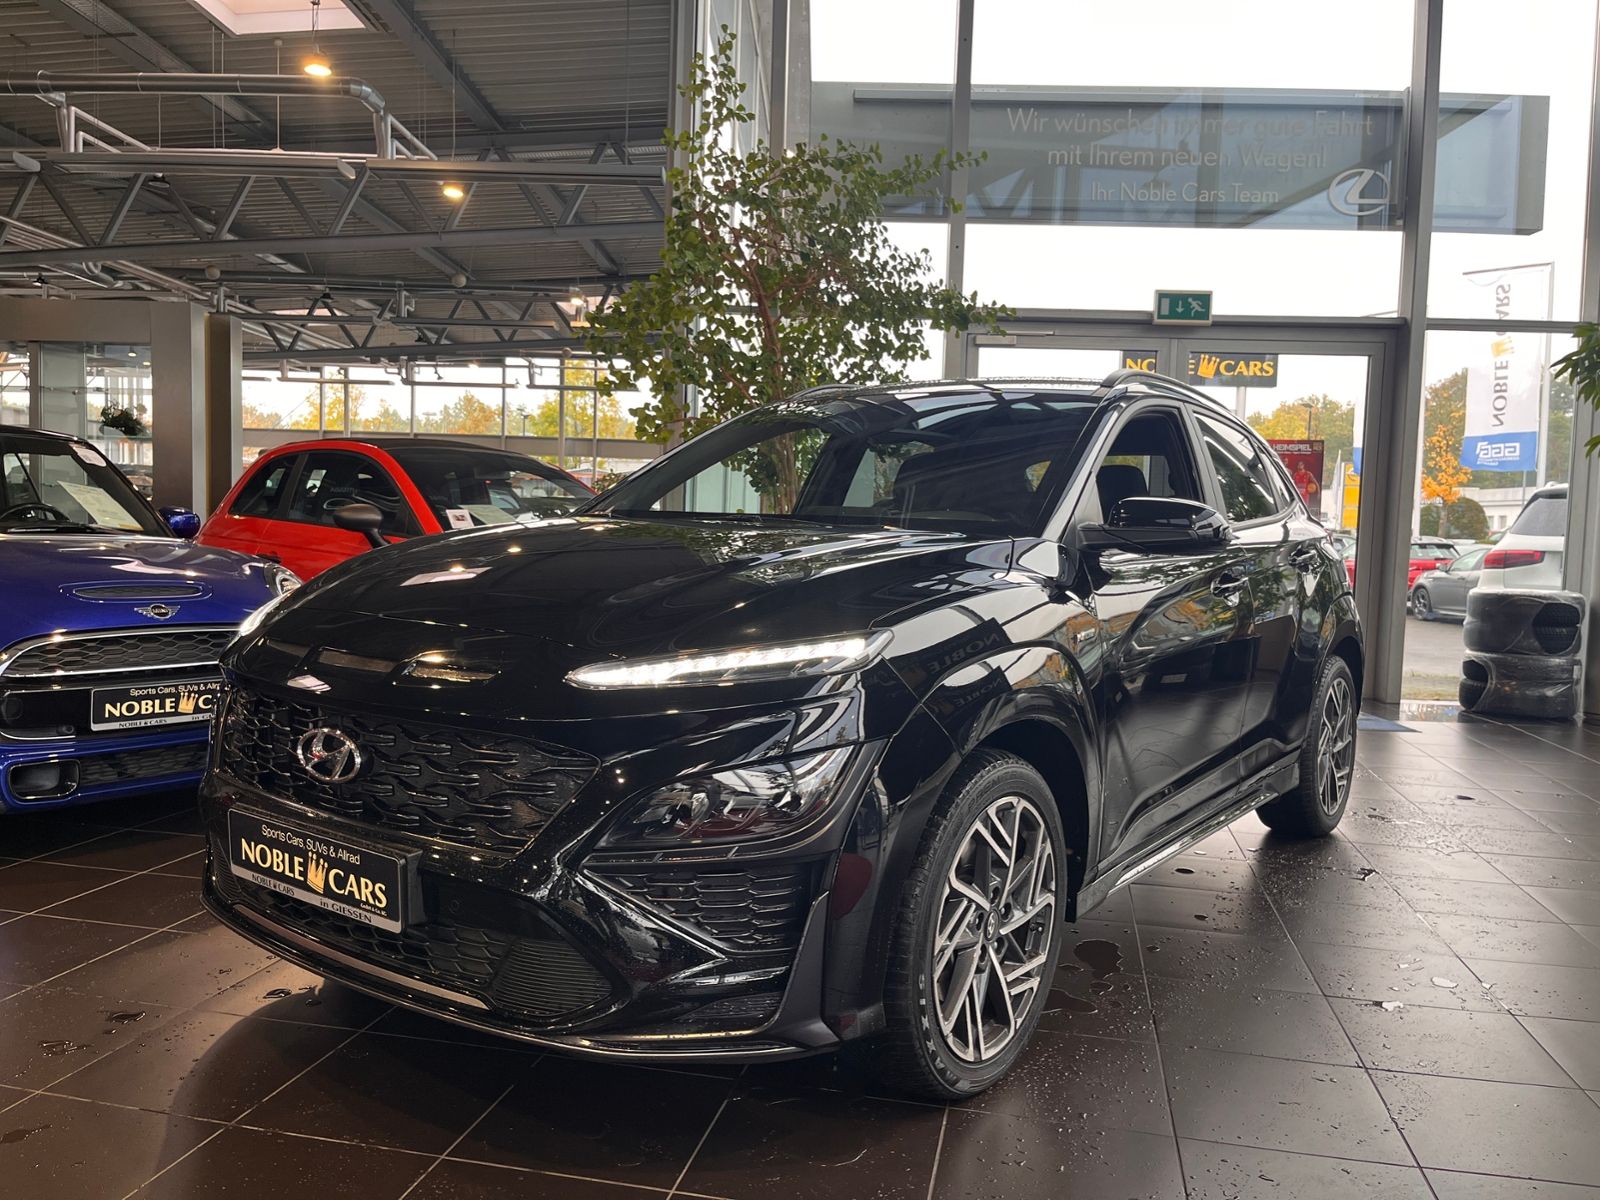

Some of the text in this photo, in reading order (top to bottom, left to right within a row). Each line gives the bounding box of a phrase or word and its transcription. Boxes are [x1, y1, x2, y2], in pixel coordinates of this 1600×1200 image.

[1007, 107, 1048, 133] Wir
[1054, 108, 1167, 134] wünschen
[1253, 116, 1306, 138] gute
[1315, 110, 1374, 135] Fahrt
[1047, 144, 1327, 172] mit Ihrem neuen Wagen!
[1091, 181, 1279, 203] Ihr Noble Cars Team
[1219, 360, 1275, 376] CARS
[130, 688, 156, 697] Sports
[178, 684, 198, 692] SUVs
[104, 698, 176, 718] NOBLE
[261, 824, 360, 865] Sports Cars, SUVs & Allrad
[241, 838, 388, 908] NOBLE CARS
[251, 873, 296, 897] NOBLE CARS
[320, 898, 372, 923] in GIESSEN
